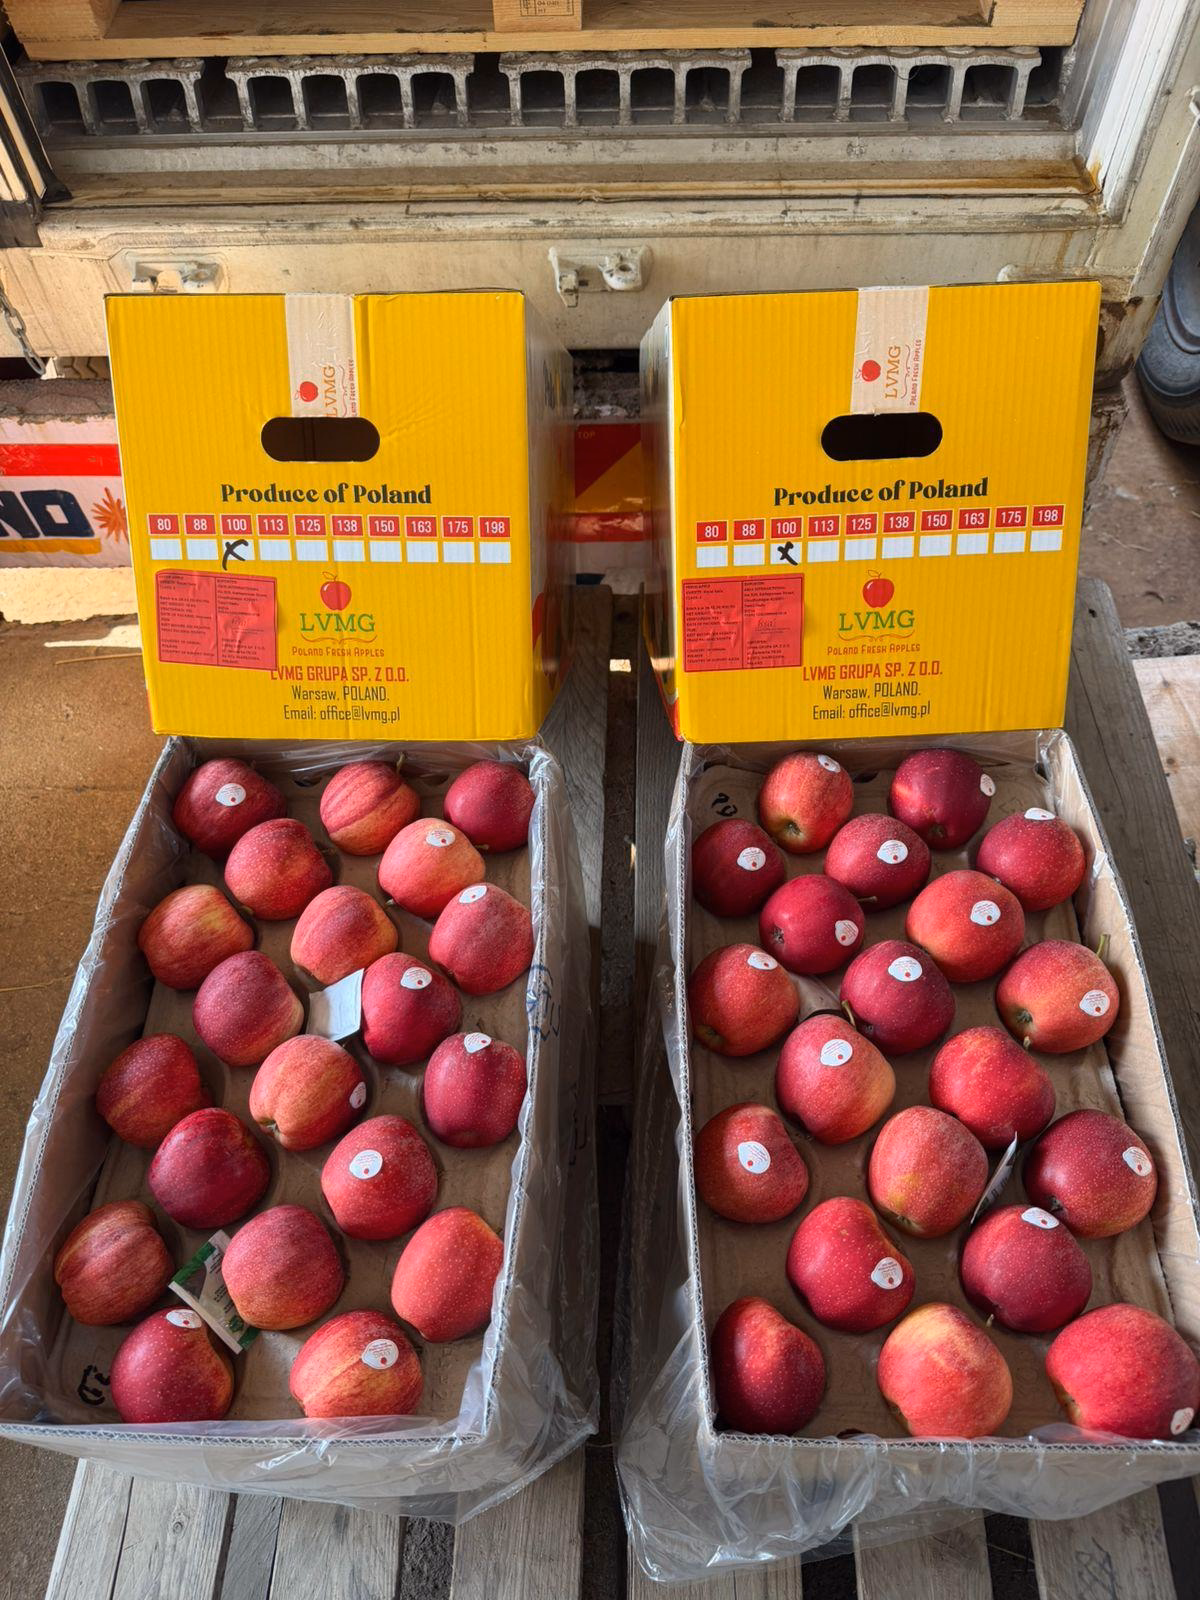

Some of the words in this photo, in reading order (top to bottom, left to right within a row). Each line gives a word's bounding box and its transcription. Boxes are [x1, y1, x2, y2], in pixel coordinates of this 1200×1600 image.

[885, 345, 901, 399] LVMG
[221, 483, 320, 503] Produce
[323, 482, 349, 503] of
[353, 484, 432, 504] Poland
[774, 484, 874, 506] Produce
[878, 479, 906, 501] of
[909, 476, 989, 500] Poland
[157, 518, 172, 531] 80
[193, 518, 208, 531] 88
[227, 518, 247, 531] 100
[263, 519, 284, 532] 113
[300, 519, 321, 532] 125
[337, 519, 358, 532] 138
[374, 520, 395, 533] 150
[411, 520, 432, 533] 163
[448, 521, 469, 534] 175
[484, 521, 505, 534] 198
[705, 525, 719, 538] 80
[741, 523, 756, 537] 88
[776, 521, 797, 535] 100
[813, 519, 834, 533] 113
[851, 517, 872, 531] 125
[888, 515, 909, 529] 138
[926, 513, 947, 527] 150
[963, 512, 985, 525] 163
[1001, 510, 1022, 524] 175
[1037, 509, 1058, 522] 198
[300, 612, 376, 632] LVMG
[838, 609, 916, 632] LVMG
[291, 646, 324, 657] POLAND
[325, 646, 352, 657] FRESH
[353, 647, 385, 658] APPLES
[827, 645, 859, 656] POLAND
[861, 644, 887, 655] FRESH
[889, 643, 921, 654] APPLES
[270, 665, 303, 681] LVMG
[306, 666, 348, 681] GRUPA
[351, 666, 372, 682] SP.
[374, 666, 383, 682] Z
[385, 667, 410, 682] O.O.
[802, 665, 836, 682] LVMG
[839, 663, 881, 680] GRUPA
[885, 662, 905, 678] SP.
[908, 661, 917, 677] Z
[919, 660, 943, 676] O.O.
[343, 686, 390, 701] POLAND.
[873, 681, 921, 698] POLAND.
[283, 704, 317, 720] Email:
[319, 705, 400, 724] office@lvmg.pl
[812, 704, 845, 720] Email:
[848, 700, 931, 719] office@lvmg.pl
